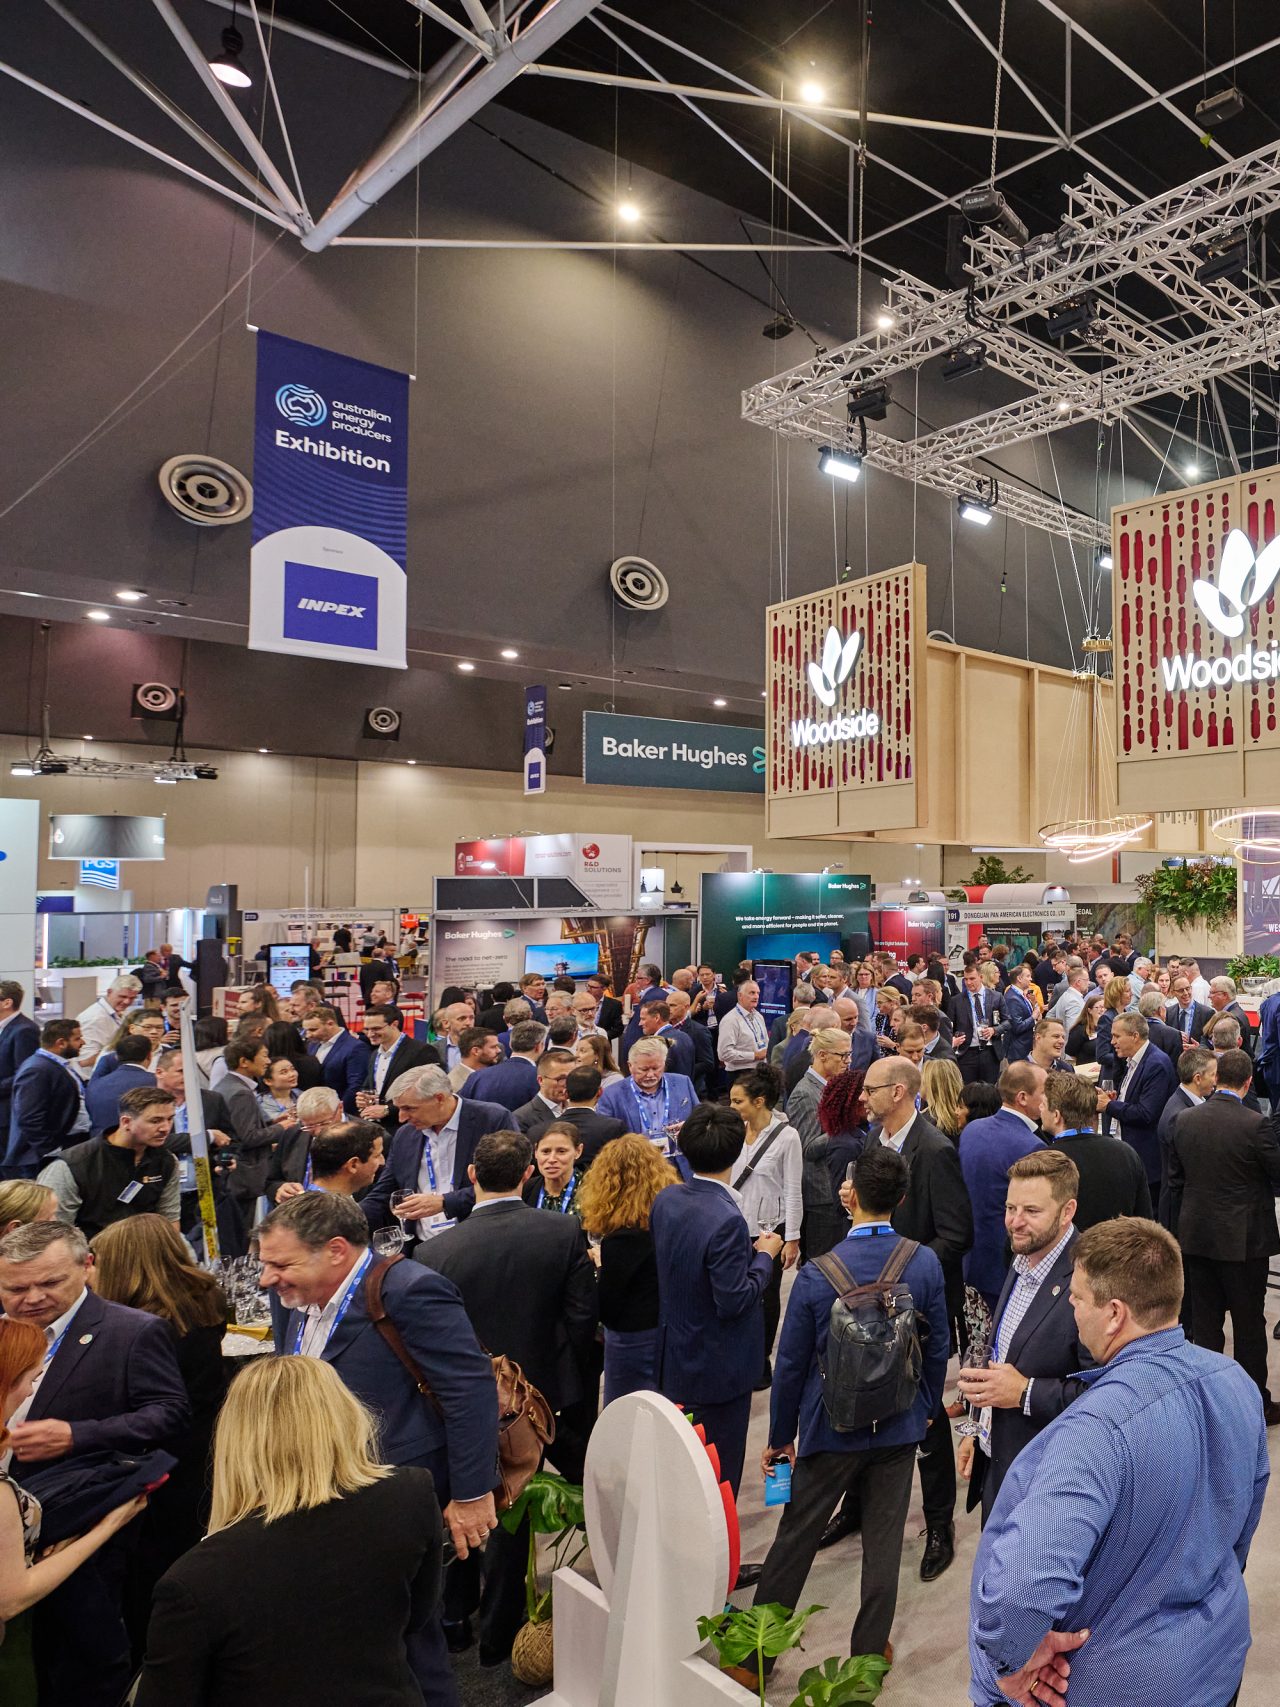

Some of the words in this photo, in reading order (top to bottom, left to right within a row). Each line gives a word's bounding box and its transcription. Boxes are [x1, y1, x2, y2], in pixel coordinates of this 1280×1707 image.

[331, 400, 392, 423] australian
[331, 410, 375, 429] energy
[331, 420, 392, 443] producers
[275, 429, 391, 473] Exhibition
[297, 597, 367, 618] INPEX
[791, 707, 880, 748] Woodside
[602, 736, 668, 760] Baker
[672, 742, 748, 769] Hughes
[444, 931, 470, 940] Baker
[471, 930, 502, 940] Hughes
